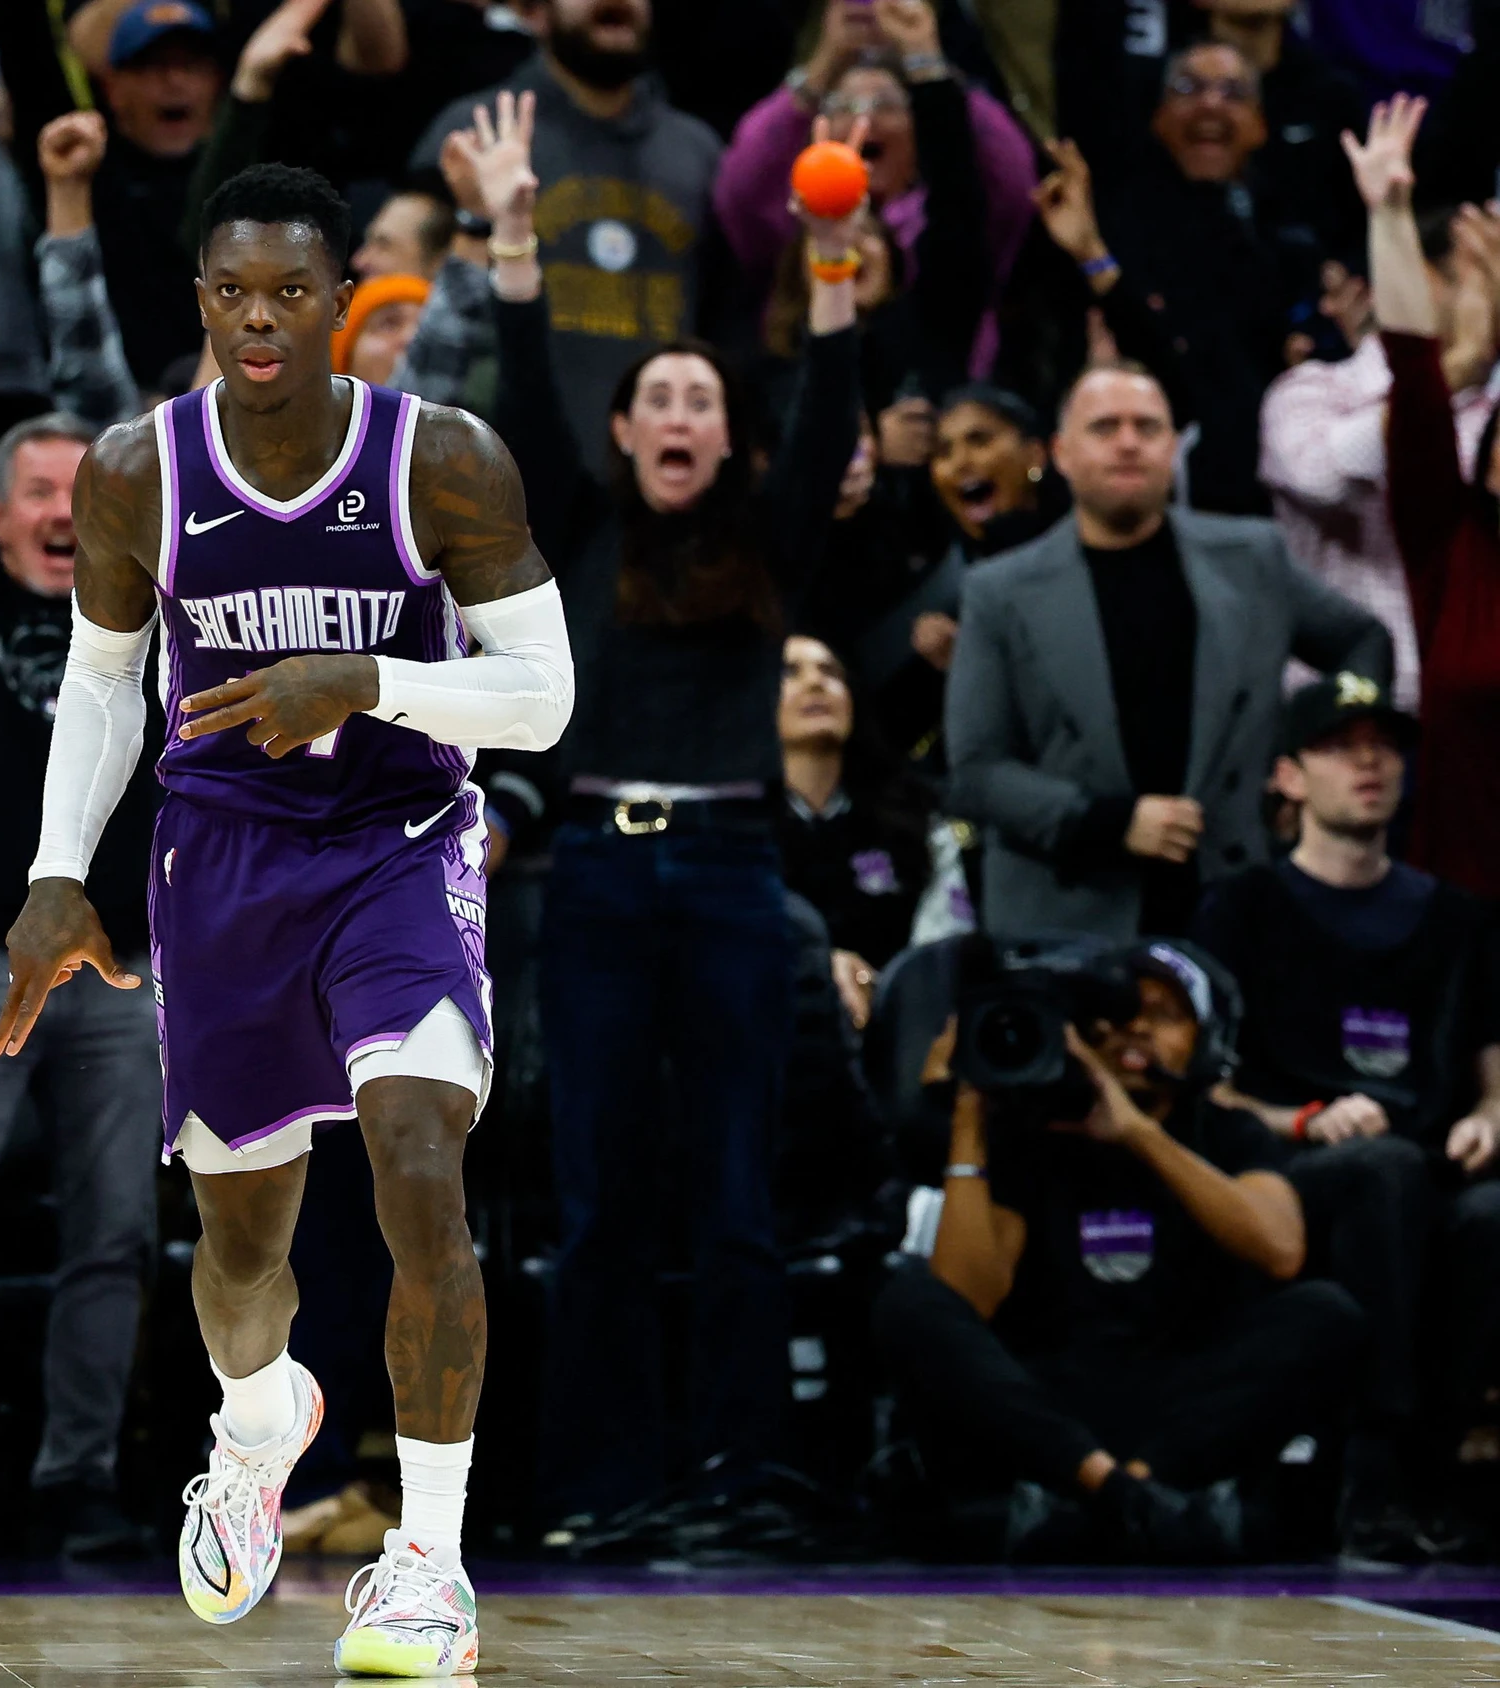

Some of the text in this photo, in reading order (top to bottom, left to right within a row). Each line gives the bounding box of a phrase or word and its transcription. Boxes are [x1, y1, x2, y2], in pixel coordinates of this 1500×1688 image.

[325, 524, 361, 532] PHOONG
[179, 586, 406, 652] SACRAMENTO
[446, 893, 486, 937] KIN
